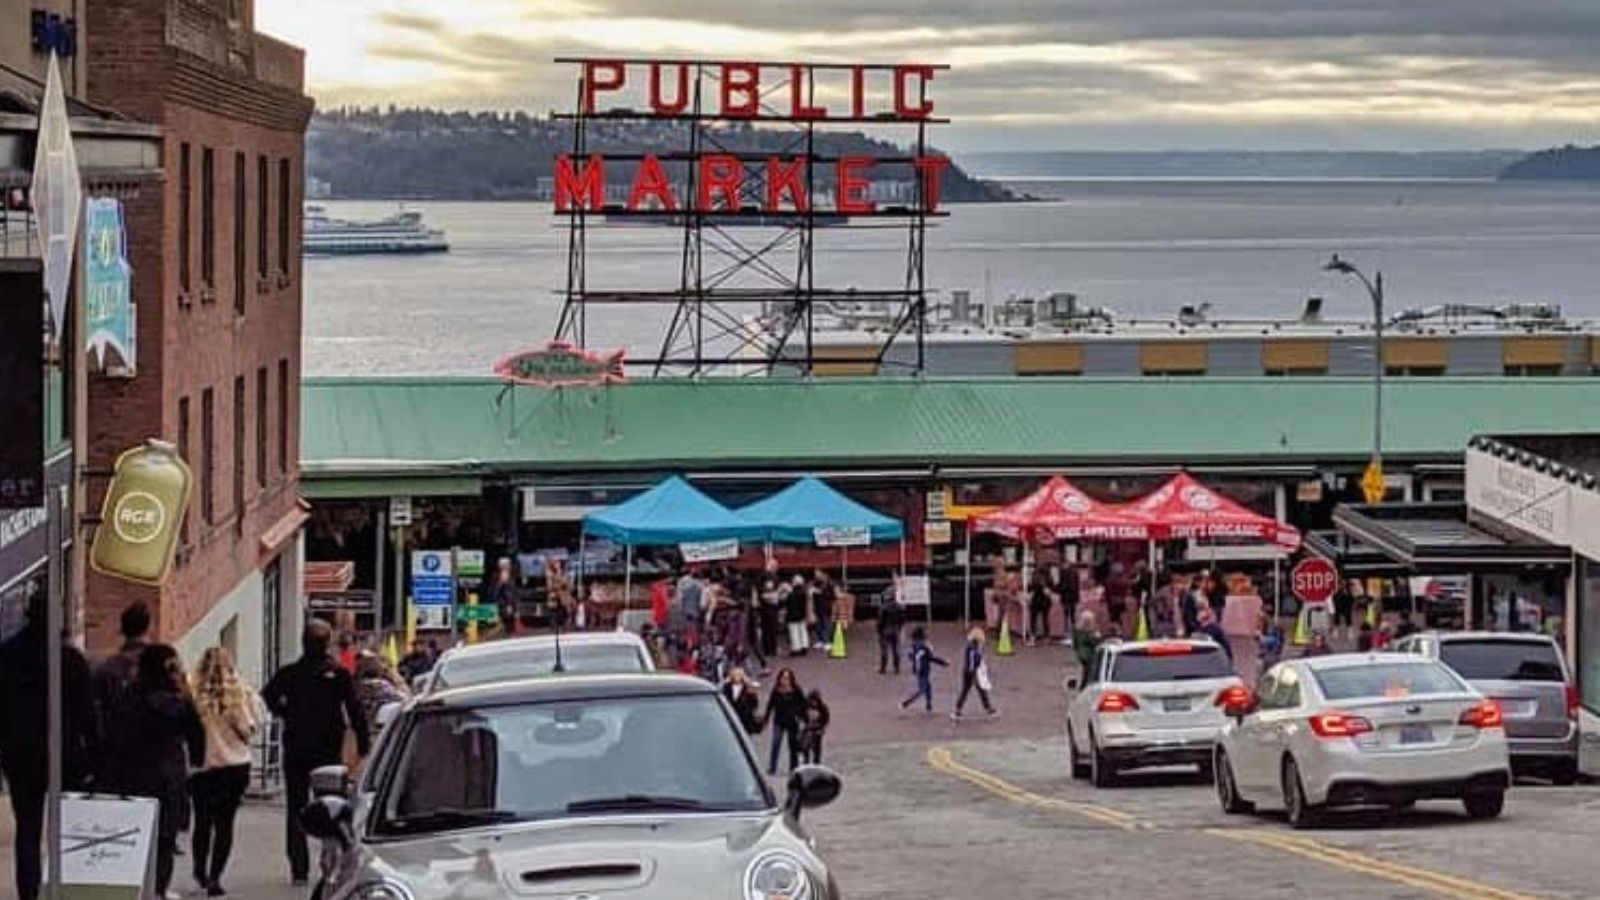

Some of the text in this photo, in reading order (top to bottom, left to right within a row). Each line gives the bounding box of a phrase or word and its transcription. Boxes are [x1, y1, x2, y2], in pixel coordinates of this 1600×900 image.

[583, 61, 934, 118] PUBLIC
[554, 154, 950, 213] MARKET
[1295, 571, 1334, 590] STOP
